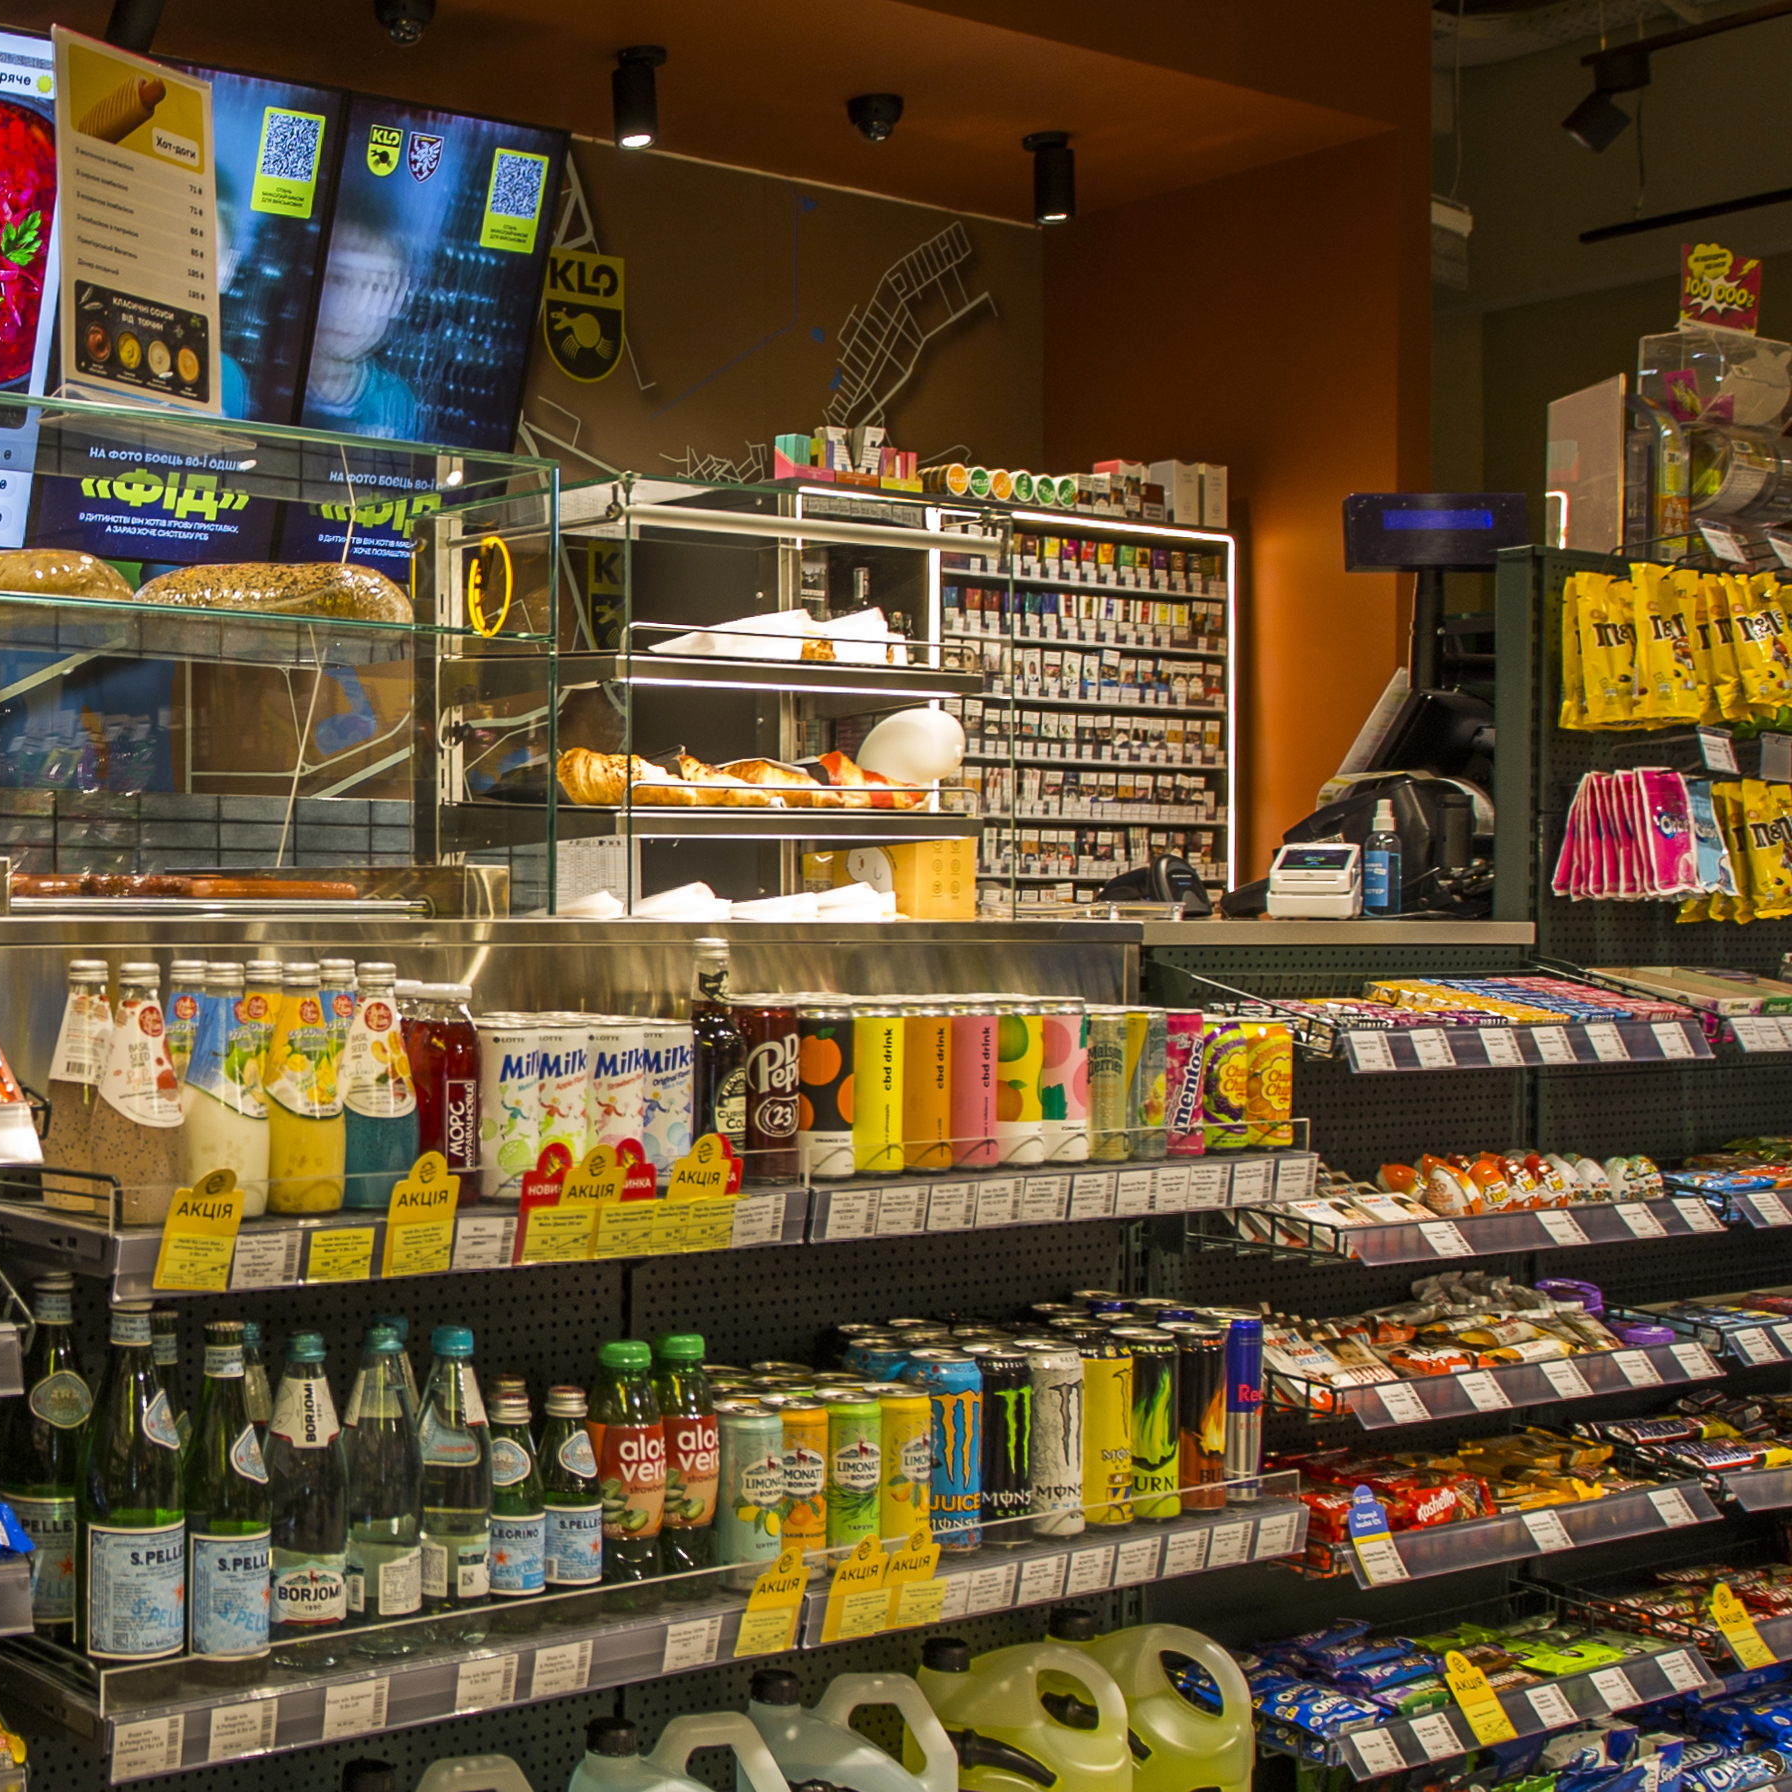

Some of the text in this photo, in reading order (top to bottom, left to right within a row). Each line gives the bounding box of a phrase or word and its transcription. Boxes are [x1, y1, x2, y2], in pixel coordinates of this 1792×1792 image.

[372, 128, 400, 146] KLO
[89, 447, 106, 460] НА
[108, 450, 141, 463] ФОТО
[145, 452, 183, 467] БОЄЦЬ
[948, 476, 967, 484] VELO
[971, 478, 989, 487] VELO
[80, 468, 250, 522] «ФІД»
[137, 527, 155, 537] ХОЧЕ
[1650, 1011, 1673, 1020] HALLS
[351, 1034, 368, 1044] BASIL
[128, 1043, 150, 1053] BASIL
[351, 1043, 368, 1053] SEED
[1087, 1044, 1123, 1058] Maison
[129, 1052, 150, 1063] SEED
[884, 1028, 893, 1090] cbd drink
[937, 1027, 945, 1090] cbd drink
[982, 1026, 992, 1088] cbd drink
[465, 1083, 475, 1168] ЖУРАВЛИНОВИЙ
[773, 1108, 792, 1128] 23
[451, 1101, 464, 1156] МОРС
[676, 1170, 720, 1187] АКЦІЯ
[397, 1191, 449, 1208] АКЦІЯ
[566, 1184, 615, 1201] АКЦІЯ
[177, 1201, 234, 1220] АКЦІЯ
[305, 1383, 317, 1443] BORJOMI
[929, 1494, 980, 1511] JUICE
[890, 1554, 932, 1573] АКЦІЯ
[838, 1566, 880, 1583] АКЦІЯ
[277, 1586, 342, 1603] BORJOMI
[757, 1578, 800, 1596] АКЦІЯ
[1719, 1611, 1745, 1628] АКЦІЯ
[1456, 1676, 1485, 1694] АКЦІЯ
